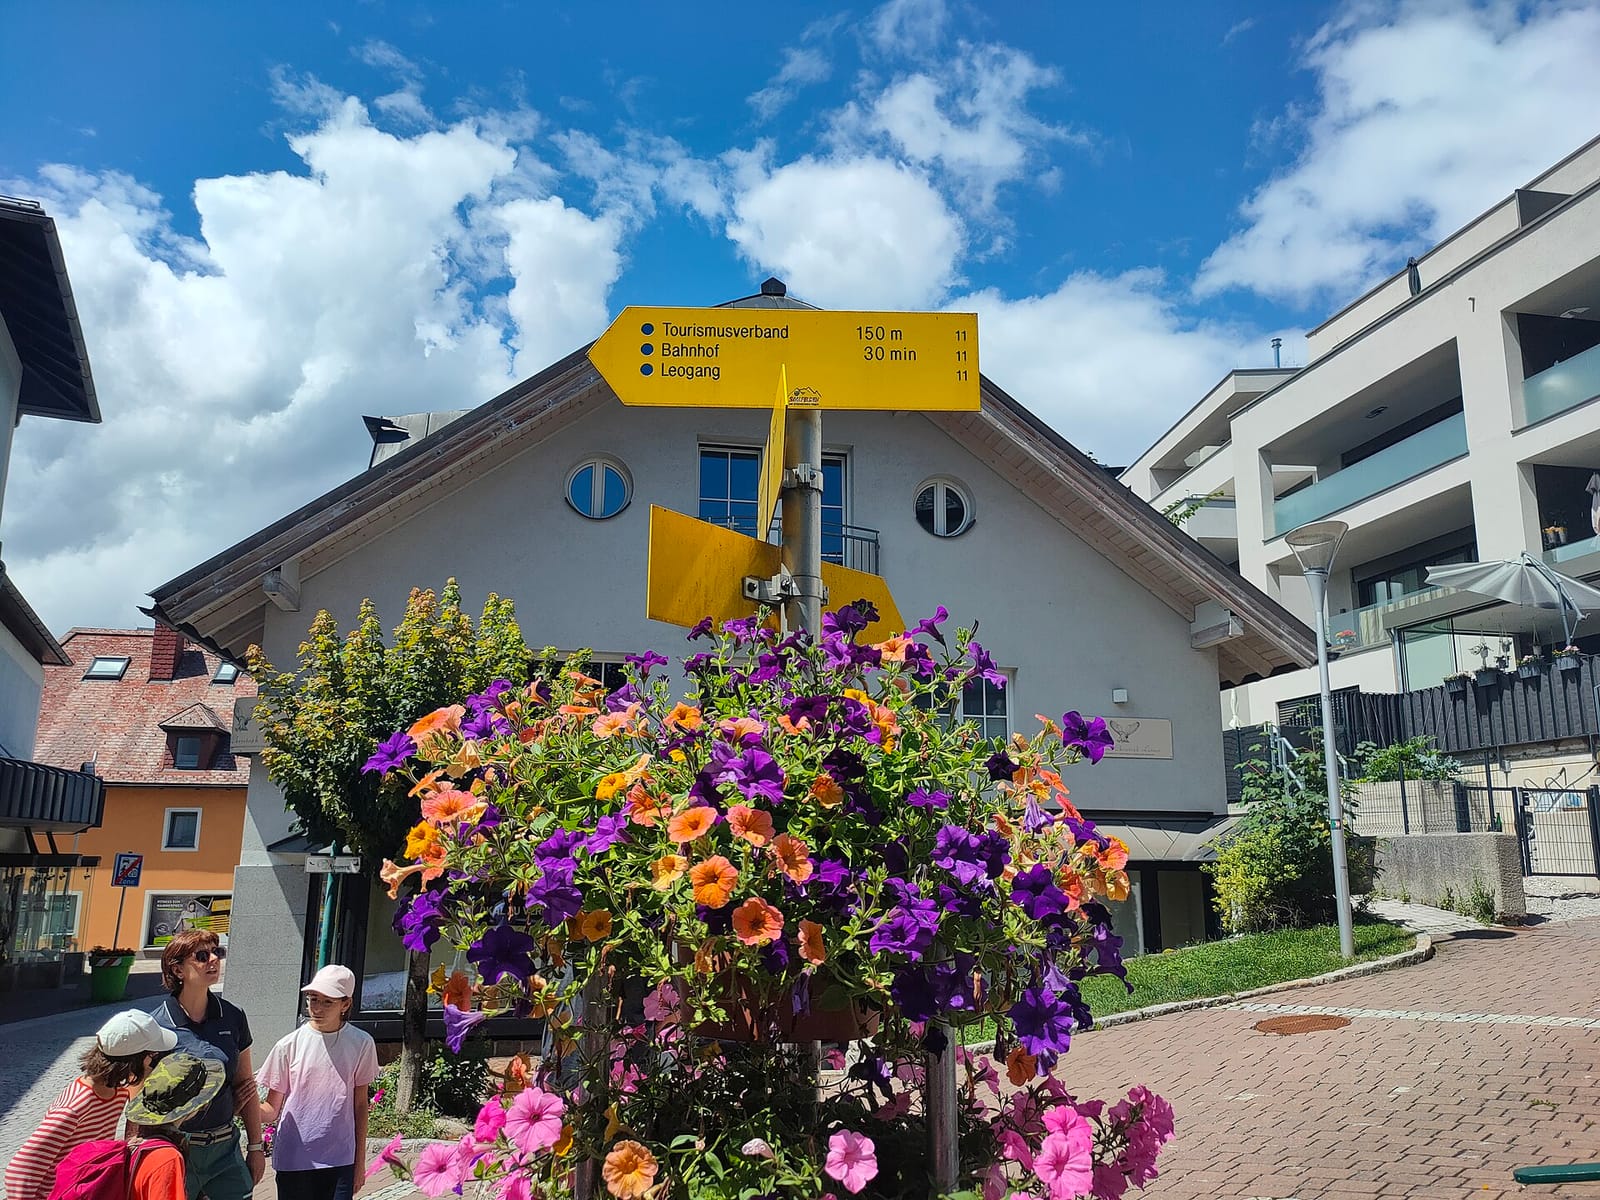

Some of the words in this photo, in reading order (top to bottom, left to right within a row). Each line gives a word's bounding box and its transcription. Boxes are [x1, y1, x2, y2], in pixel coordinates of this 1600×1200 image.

[662, 322, 789, 339] Tourismusverband
[856, 326, 885, 341] 150
[890, 329, 903, 341] m
[955, 330, 967, 342] 11
[661, 342, 720, 358] Bahnhof
[863, 346, 885, 361] 30
[890, 347, 917, 361] min
[956, 350, 967, 362] 11
[661, 363, 720, 381] Leogang
[956, 370, 968, 382] 11
